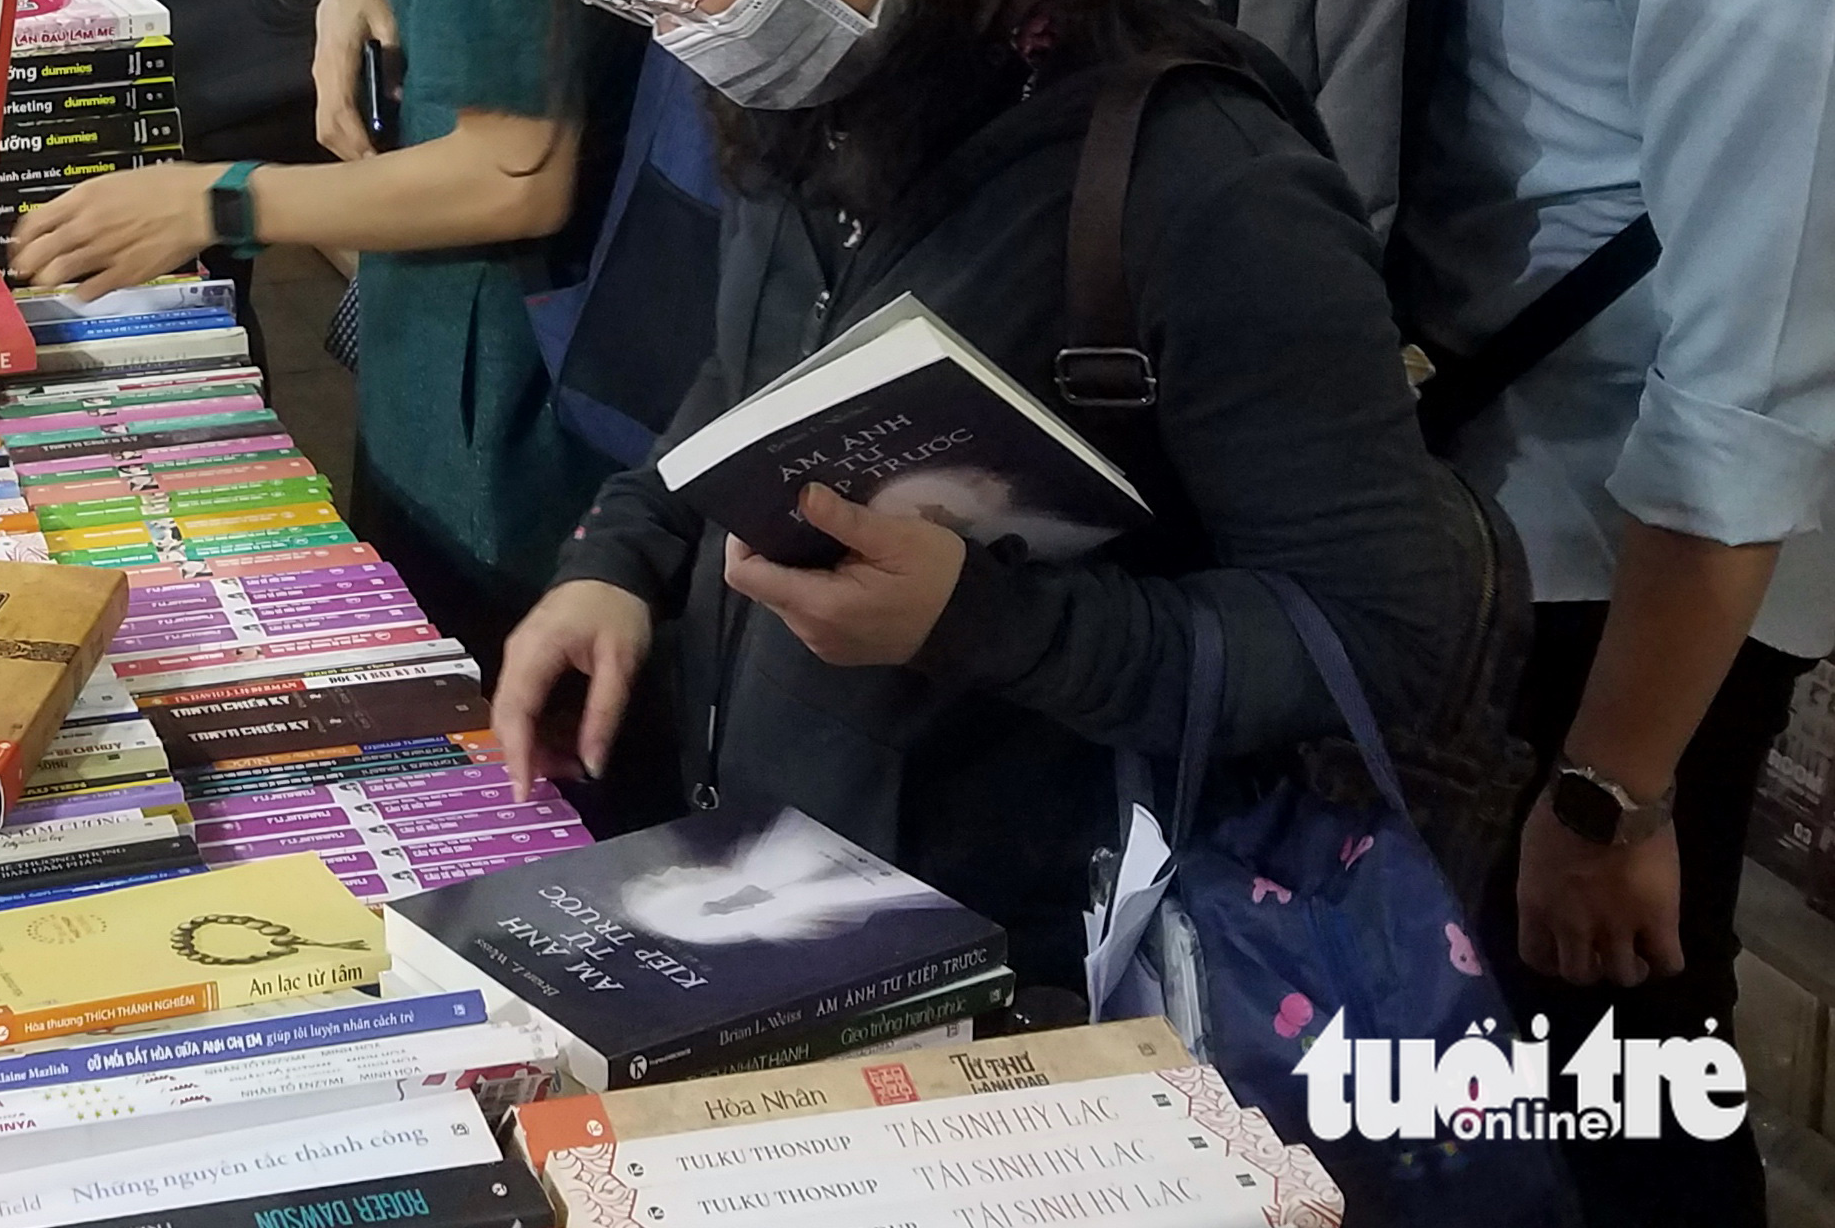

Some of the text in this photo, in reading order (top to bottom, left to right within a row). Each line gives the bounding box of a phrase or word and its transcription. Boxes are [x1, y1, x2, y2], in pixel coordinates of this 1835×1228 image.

[41, 63, 93, 77] dummies
[64, 94, 116, 109] dummies
[46, 131, 98, 146] dummies
[64, 161, 116, 177] dummies
[861, 427, 975, 480] TRƯỚC
[170, 701, 220, 718] TANYA
[189, 725, 239, 743] TANYA
[497, 915, 625, 992] ÁM ẢNH
[538, 884, 709, 989] KIẾP TRƯỚC
[560, 931, 615, 961] TỪ
[24, 962, 364, 1034] Hòa thượng THÍCH THÁNH NGHIÊM An lạc từ tâm
[703, 1088, 758, 1123] Hòa
[762, 1083, 829, 1115] Nhân
[675, 1094, 1120, 1172] TULKU THONDUP TÁI SINH HỶ LẠC
[72, 1181, 161, 1207] Những
[162, 1162, 248, 1194] nguyên
[253, 1152, 291, 1173] tắc
[292, 1133, 364, 1166] thành
[367, 1125, 430, 1153] công
[696, 1138, 1156, 1217] TULKU THONDUP TÁI SINH HỶ LẠC
